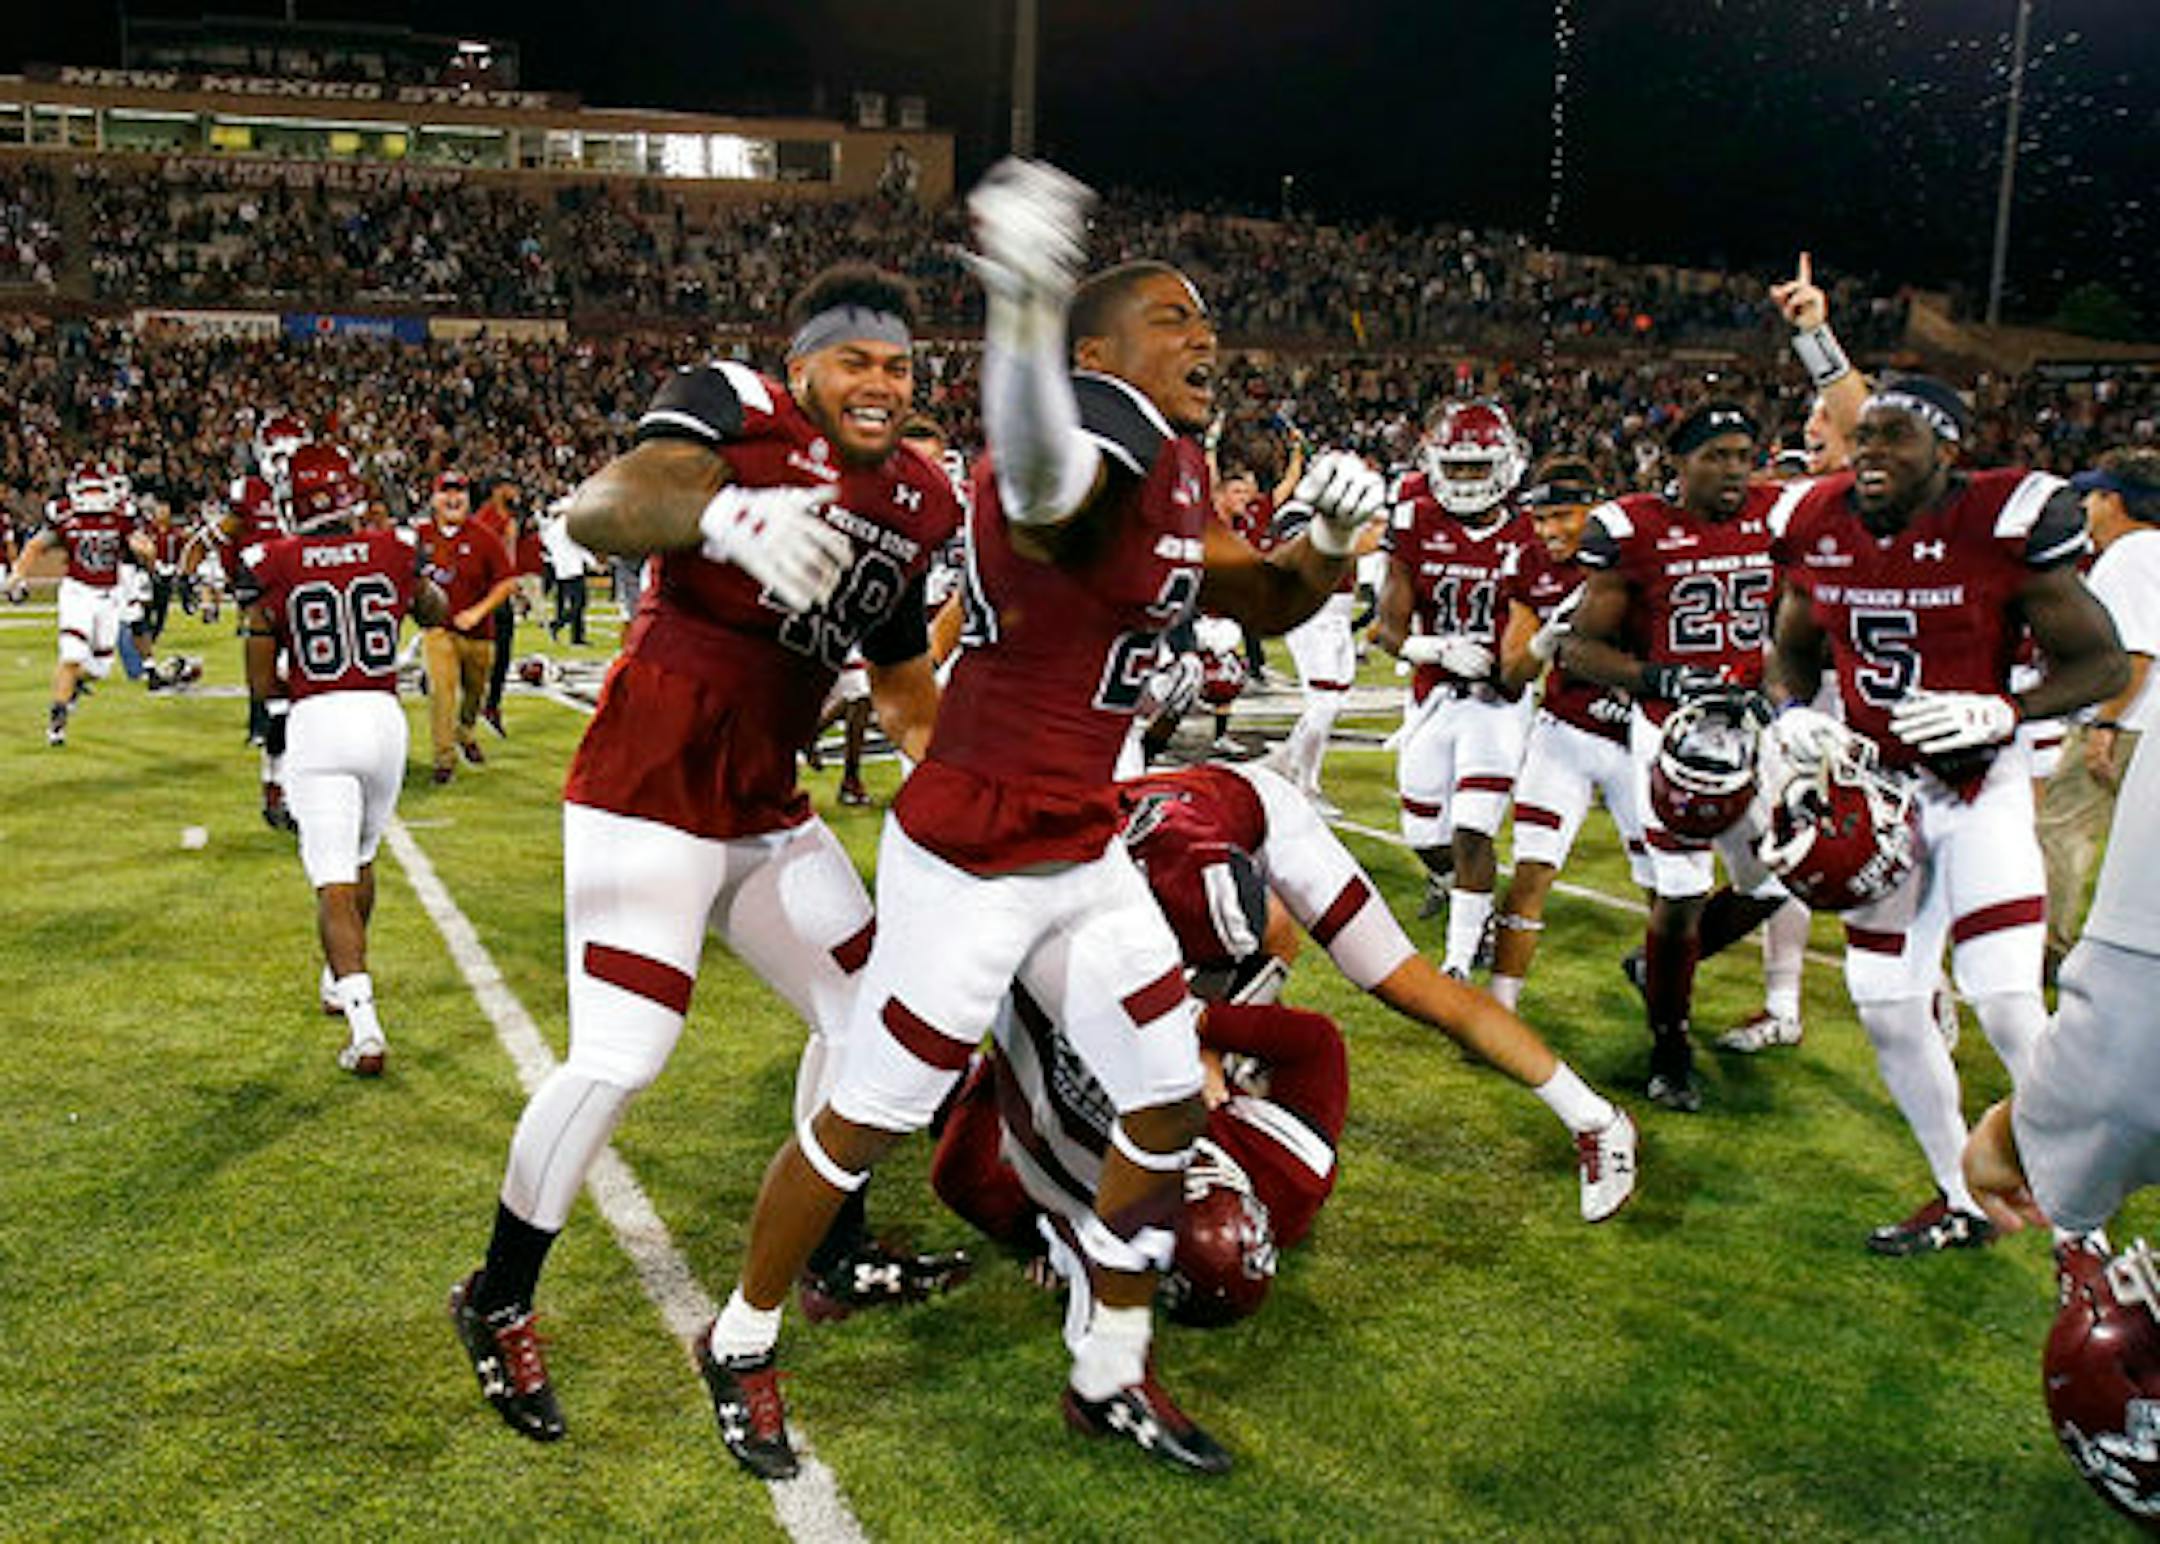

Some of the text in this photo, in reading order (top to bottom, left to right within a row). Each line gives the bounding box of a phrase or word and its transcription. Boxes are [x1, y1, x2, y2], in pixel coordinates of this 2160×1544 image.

[61, 66, 549, 111] NEW MEXICO STATE
[286, 571, 398, 681] 86
[1433, 576, 1497, 643] 11
[1669, 568, 1774, 652] 25
[1851, 608, 1922, 708] 5
